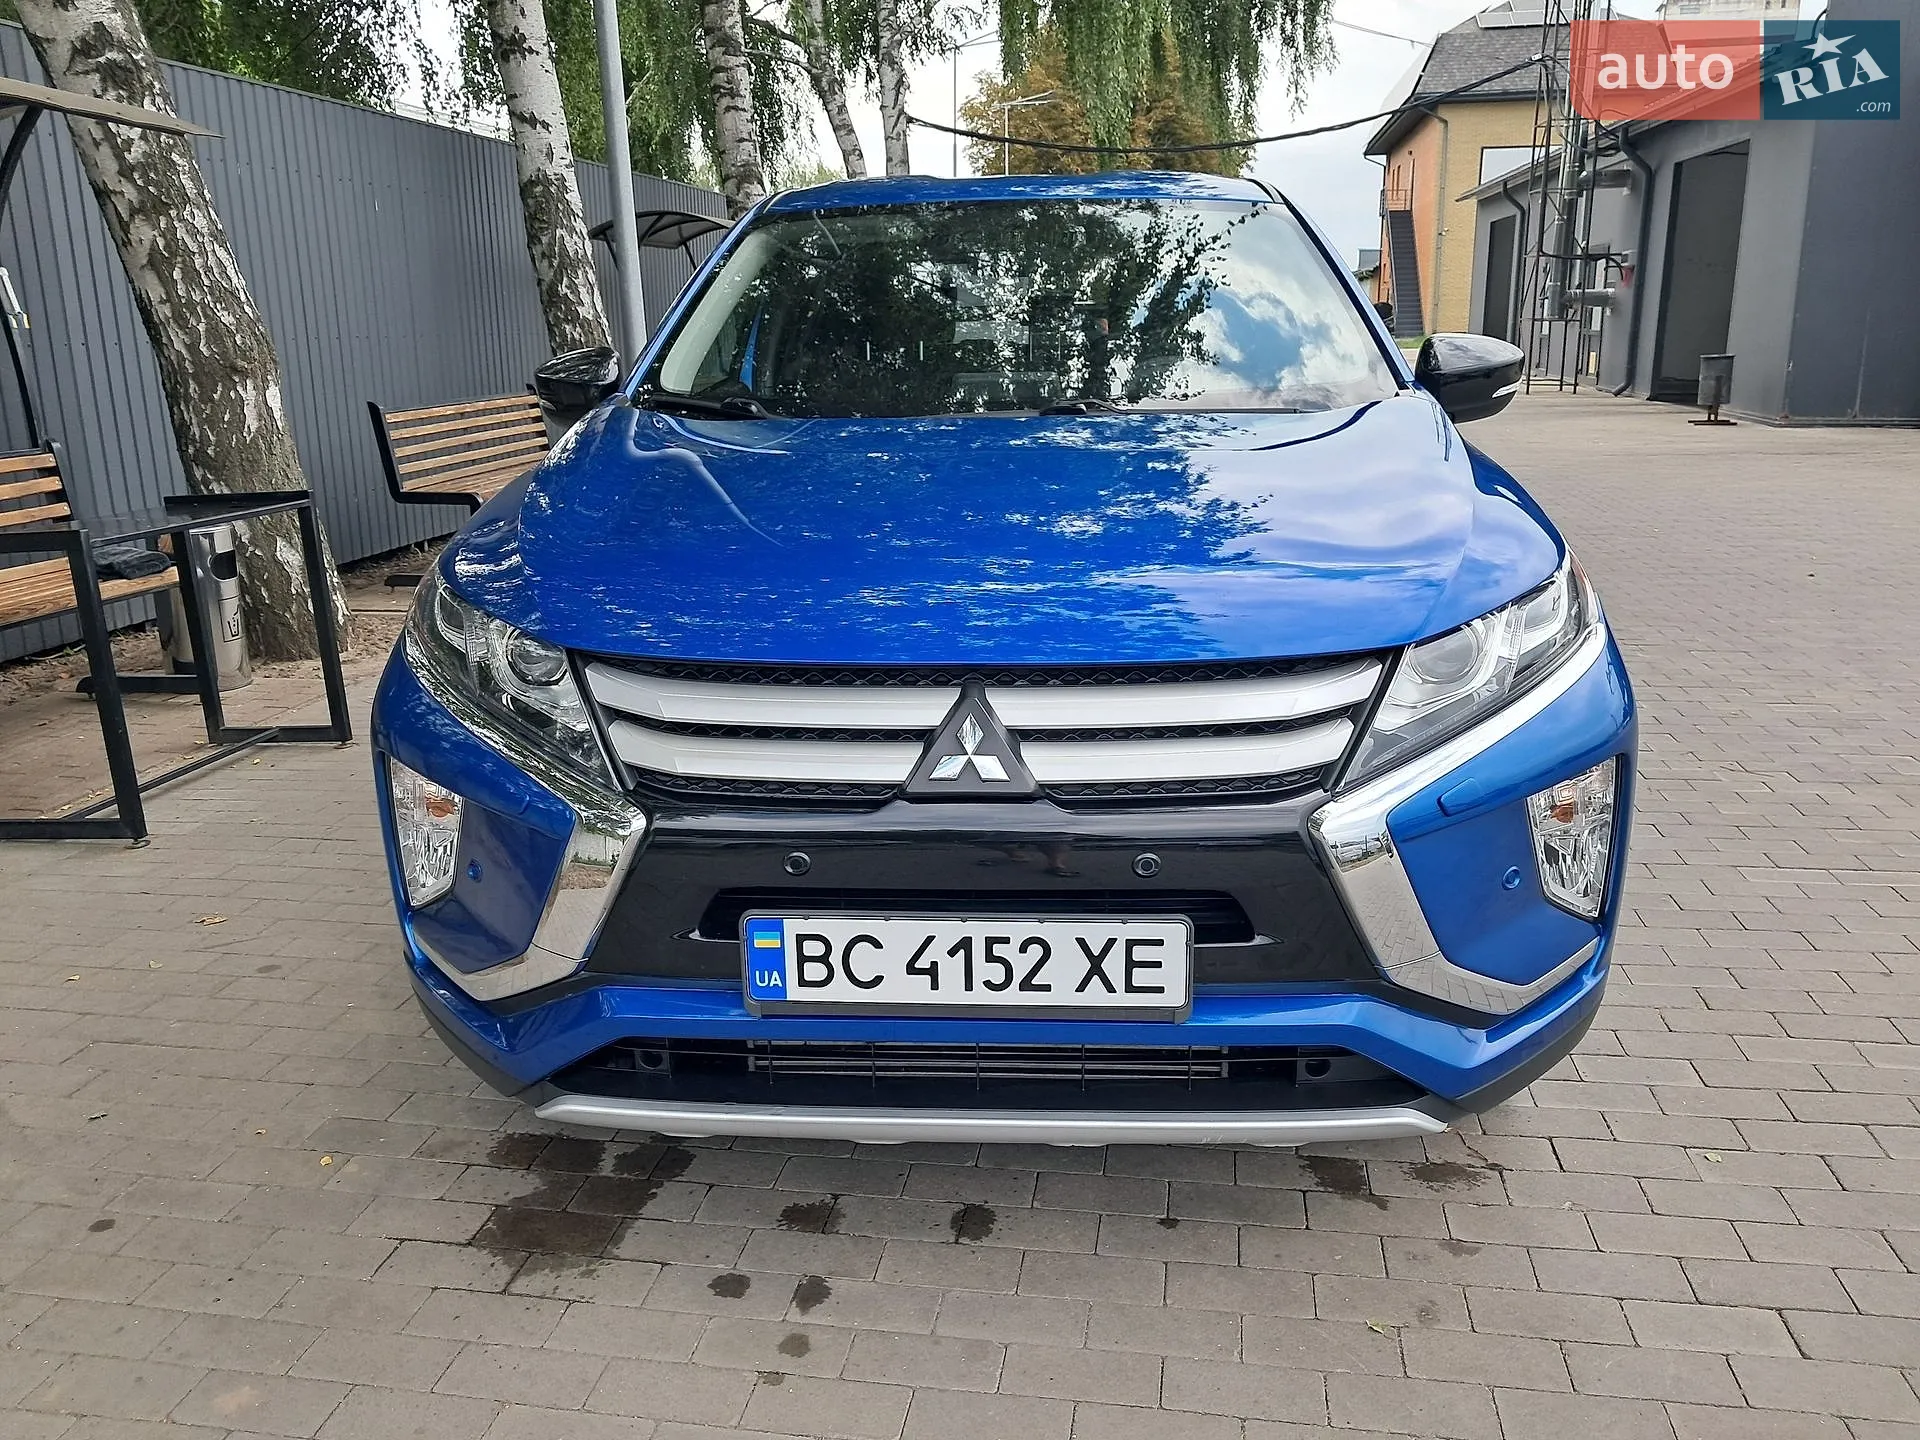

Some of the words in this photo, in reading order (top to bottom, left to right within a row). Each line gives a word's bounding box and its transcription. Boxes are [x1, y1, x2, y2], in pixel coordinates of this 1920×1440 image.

[755, 970, 783, 988] UA
[795, 933, 885, 990] BC
[905, 935, 1053, 993] 4152
[1073, 936, 1166, 994] XE
